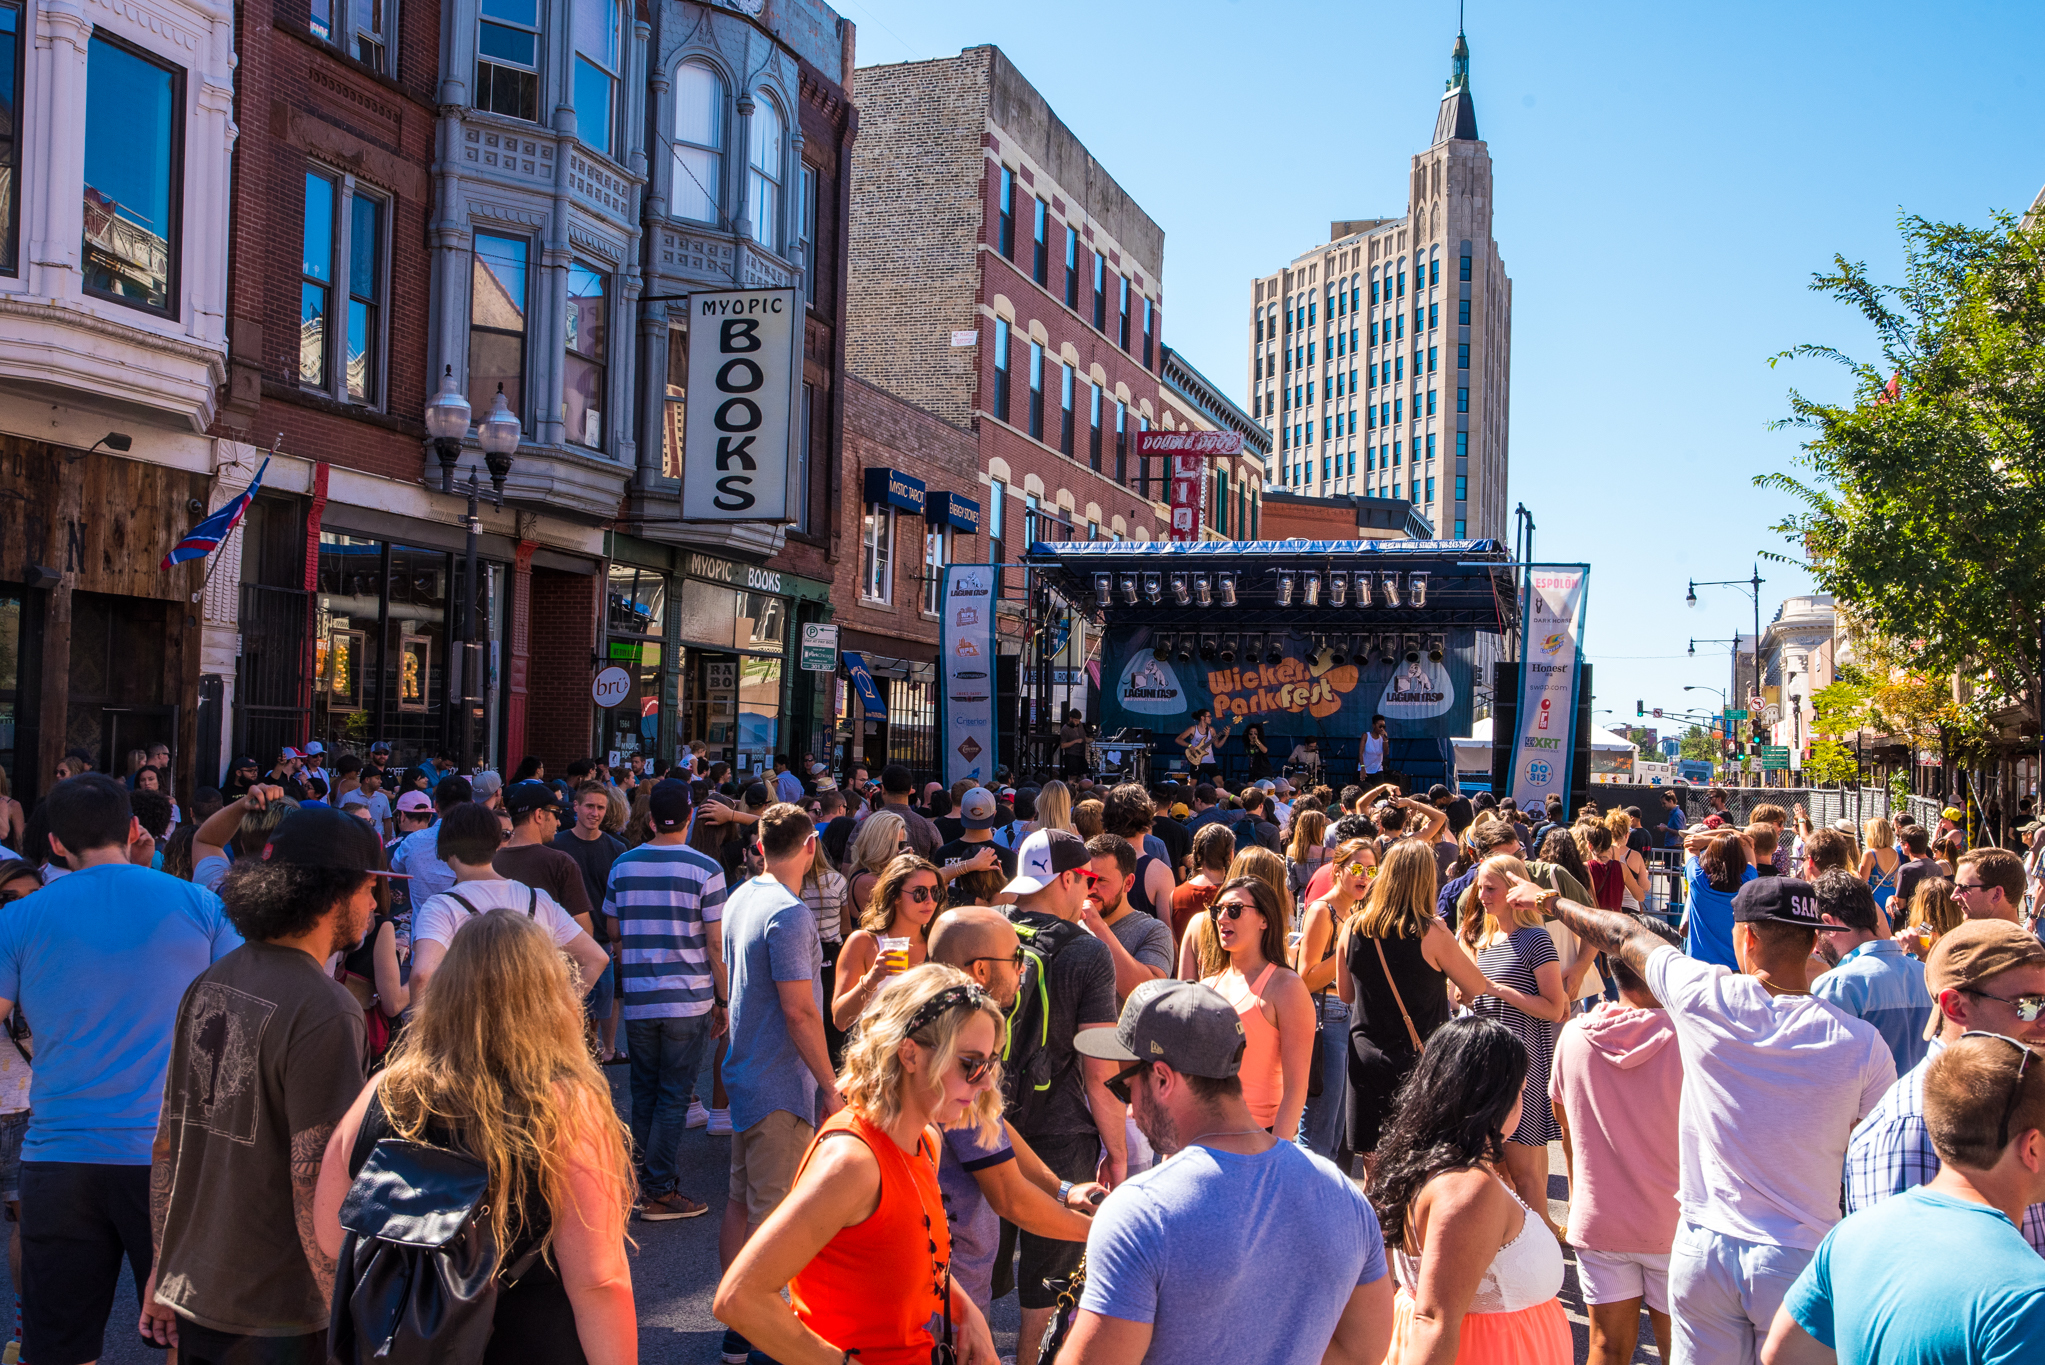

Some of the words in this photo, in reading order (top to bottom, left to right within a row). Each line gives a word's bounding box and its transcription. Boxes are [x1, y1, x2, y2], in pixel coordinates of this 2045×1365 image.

[702, 297, 783, 316] MYOPIC
[713, 318, 764, 511] BOOKS
[1142, 435, 1195, 450] DOUBLE
[1196, 435, 1237, 450] DOOR
[889, 480, 908, 498] MYSTIC
[909, 486, 924, 504] TAROT
[1173, 455, 1196, 541] LIQ
[949, 502, 964, 518] ENERGY
[691, 553, 732, 583] MYOPIC
[748, 567, 781, 593] BOOKS
[950, 589, 987, 597] LAGUNITAS
[710, 665, 733, 675] RA
[1532, 664, 1568, 673] Honest
[1208, 663, 1305, 695] Wicker
[1124, 688, 1173, 698] LAGUNITAS
[1529, 684, 1568, 692] swap.com
[1386, 692, 1439, 702] LAGUNITAS
[619, 719, 630, 728] 1564
[956, 716, 987, 725] Criterion
[1534, 736, 1561, 750] XRT
[1530, 763, 1549, 773] DO
[1529, 772, 1547, 782] 312
